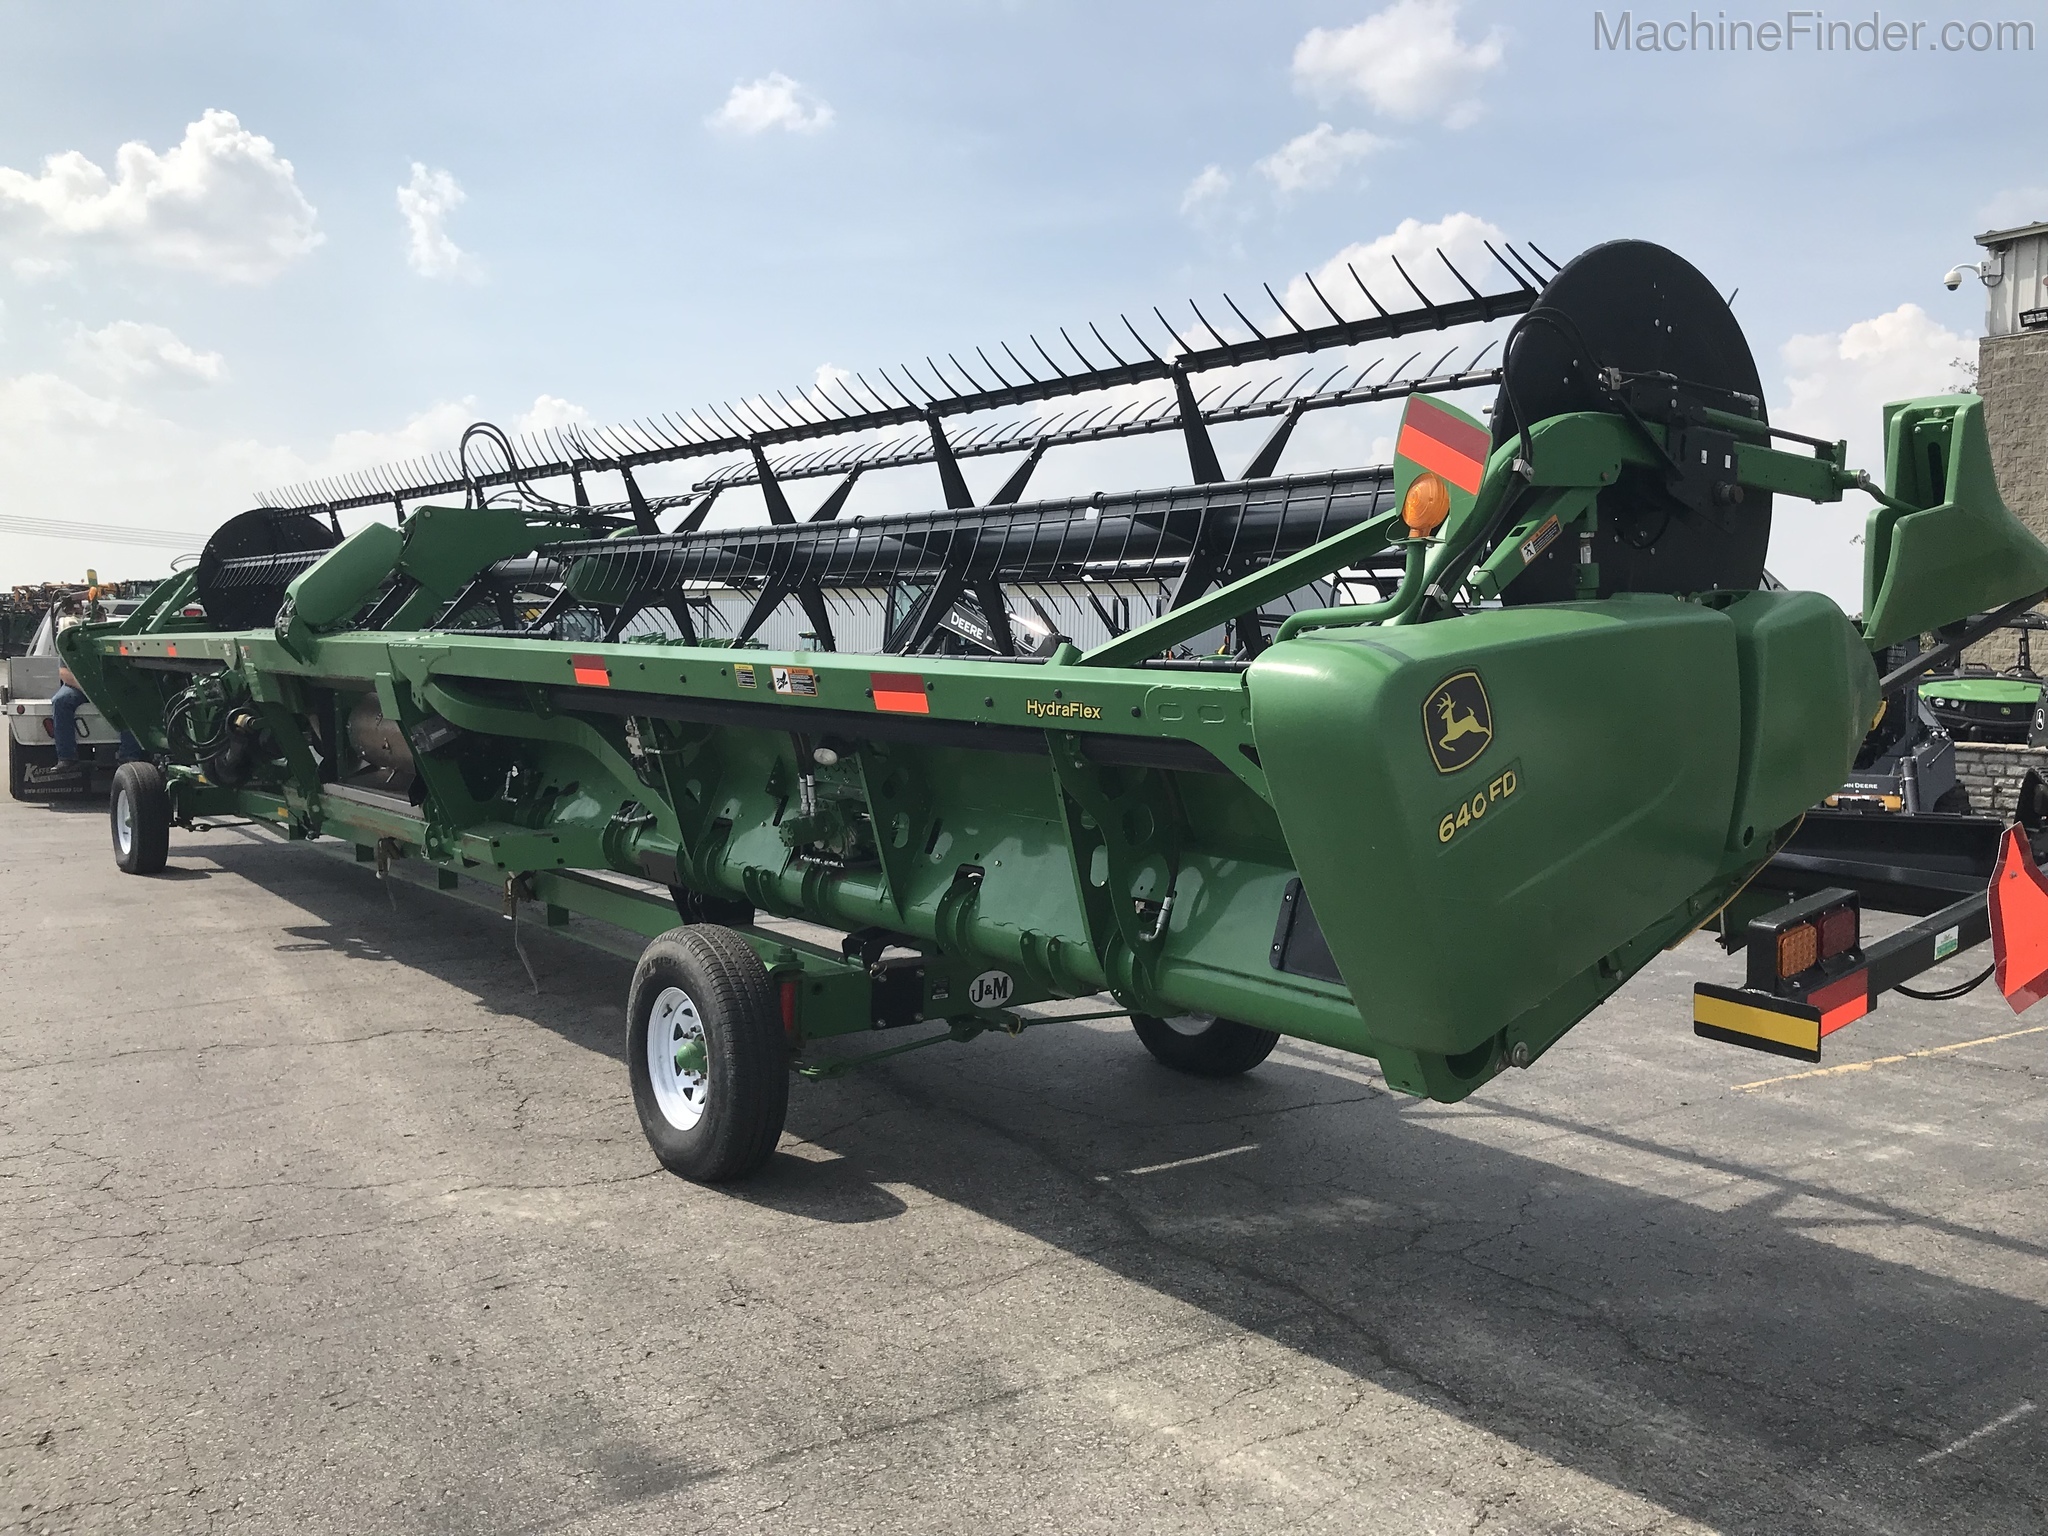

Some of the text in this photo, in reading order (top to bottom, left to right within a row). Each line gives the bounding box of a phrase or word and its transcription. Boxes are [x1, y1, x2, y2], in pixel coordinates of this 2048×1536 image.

[950, 611, 984, 640] DEERE
[1026, 699, 1102, 719] HydraFlex
[1438, 769, 1517, 843] 640 FD
[971, 976, 1009, 1003] J&M
